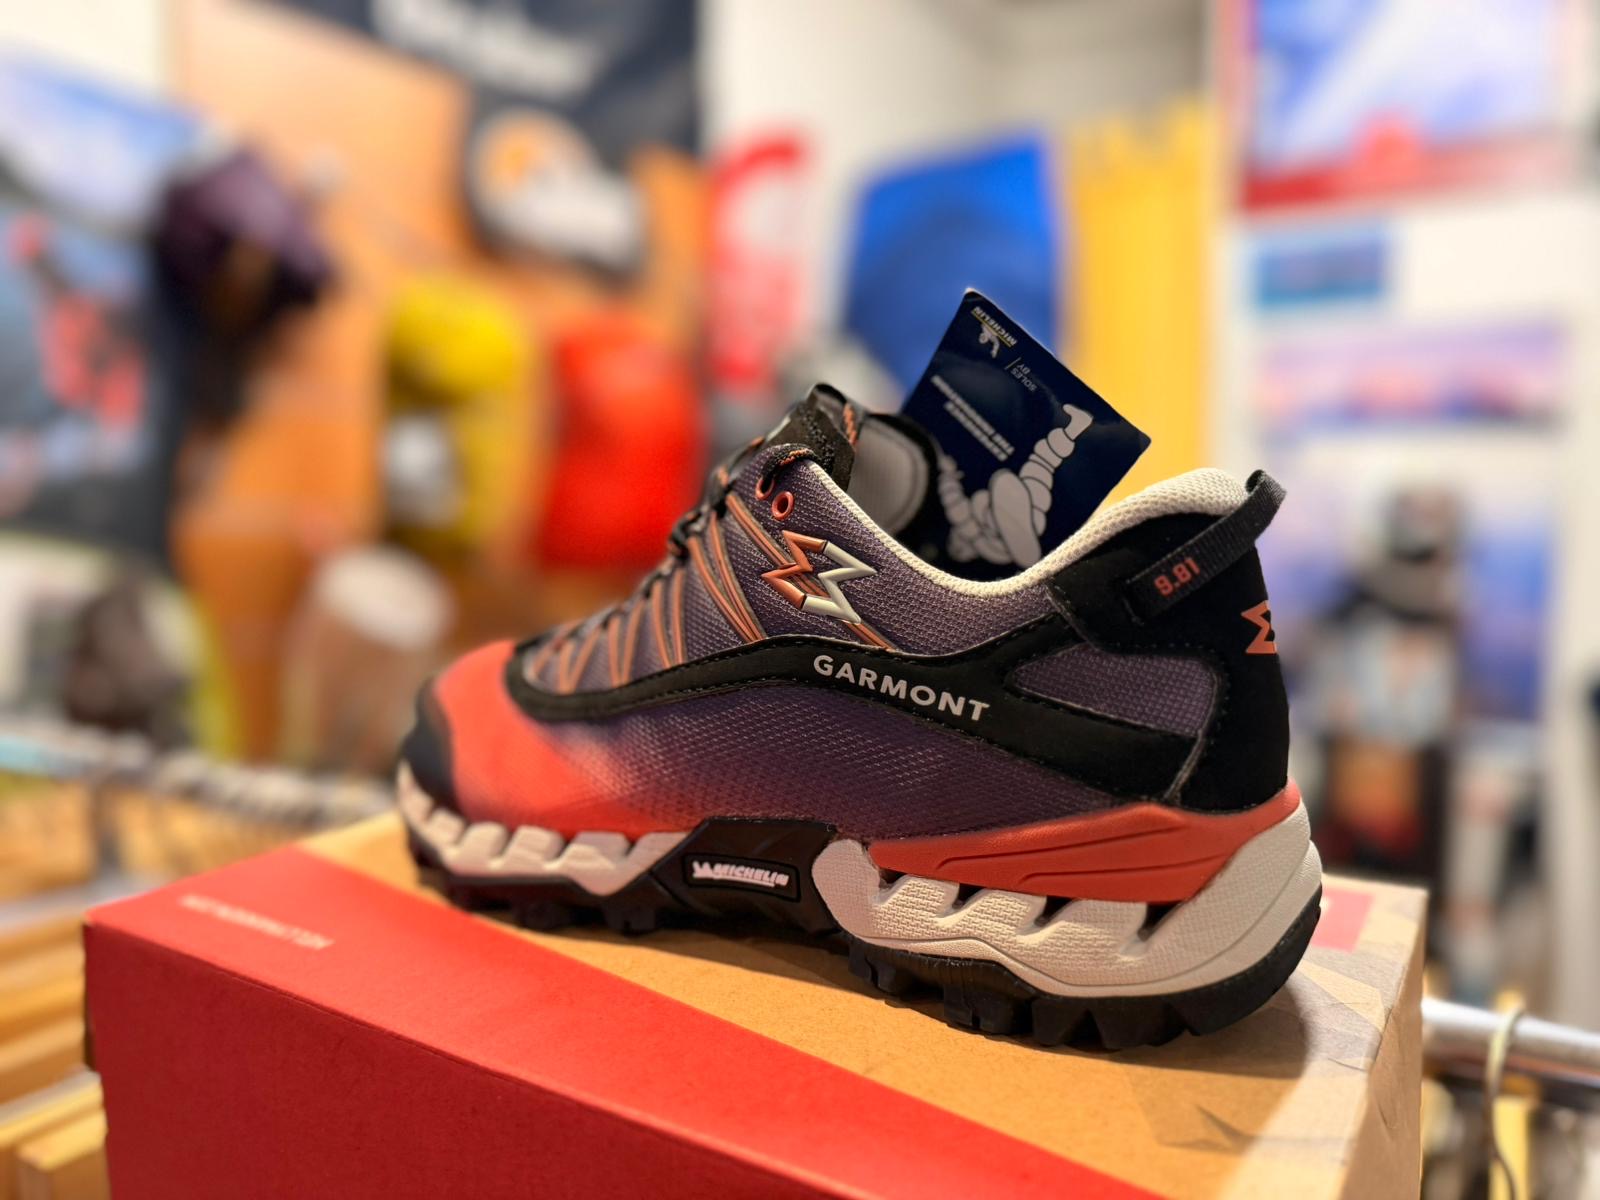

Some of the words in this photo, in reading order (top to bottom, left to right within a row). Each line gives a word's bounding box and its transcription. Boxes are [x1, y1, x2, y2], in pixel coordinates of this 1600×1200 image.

[972, 306, 1017, 346] MICHELIN
[1011, 367, 1037, 392] SOLES
[1016, 363, 1031, 375] BY
[1153, 557, 1200, 596] 9.81
[813, 654, 990, 721] GARMONT
[712, 863, 789, 887] MICHELIN
